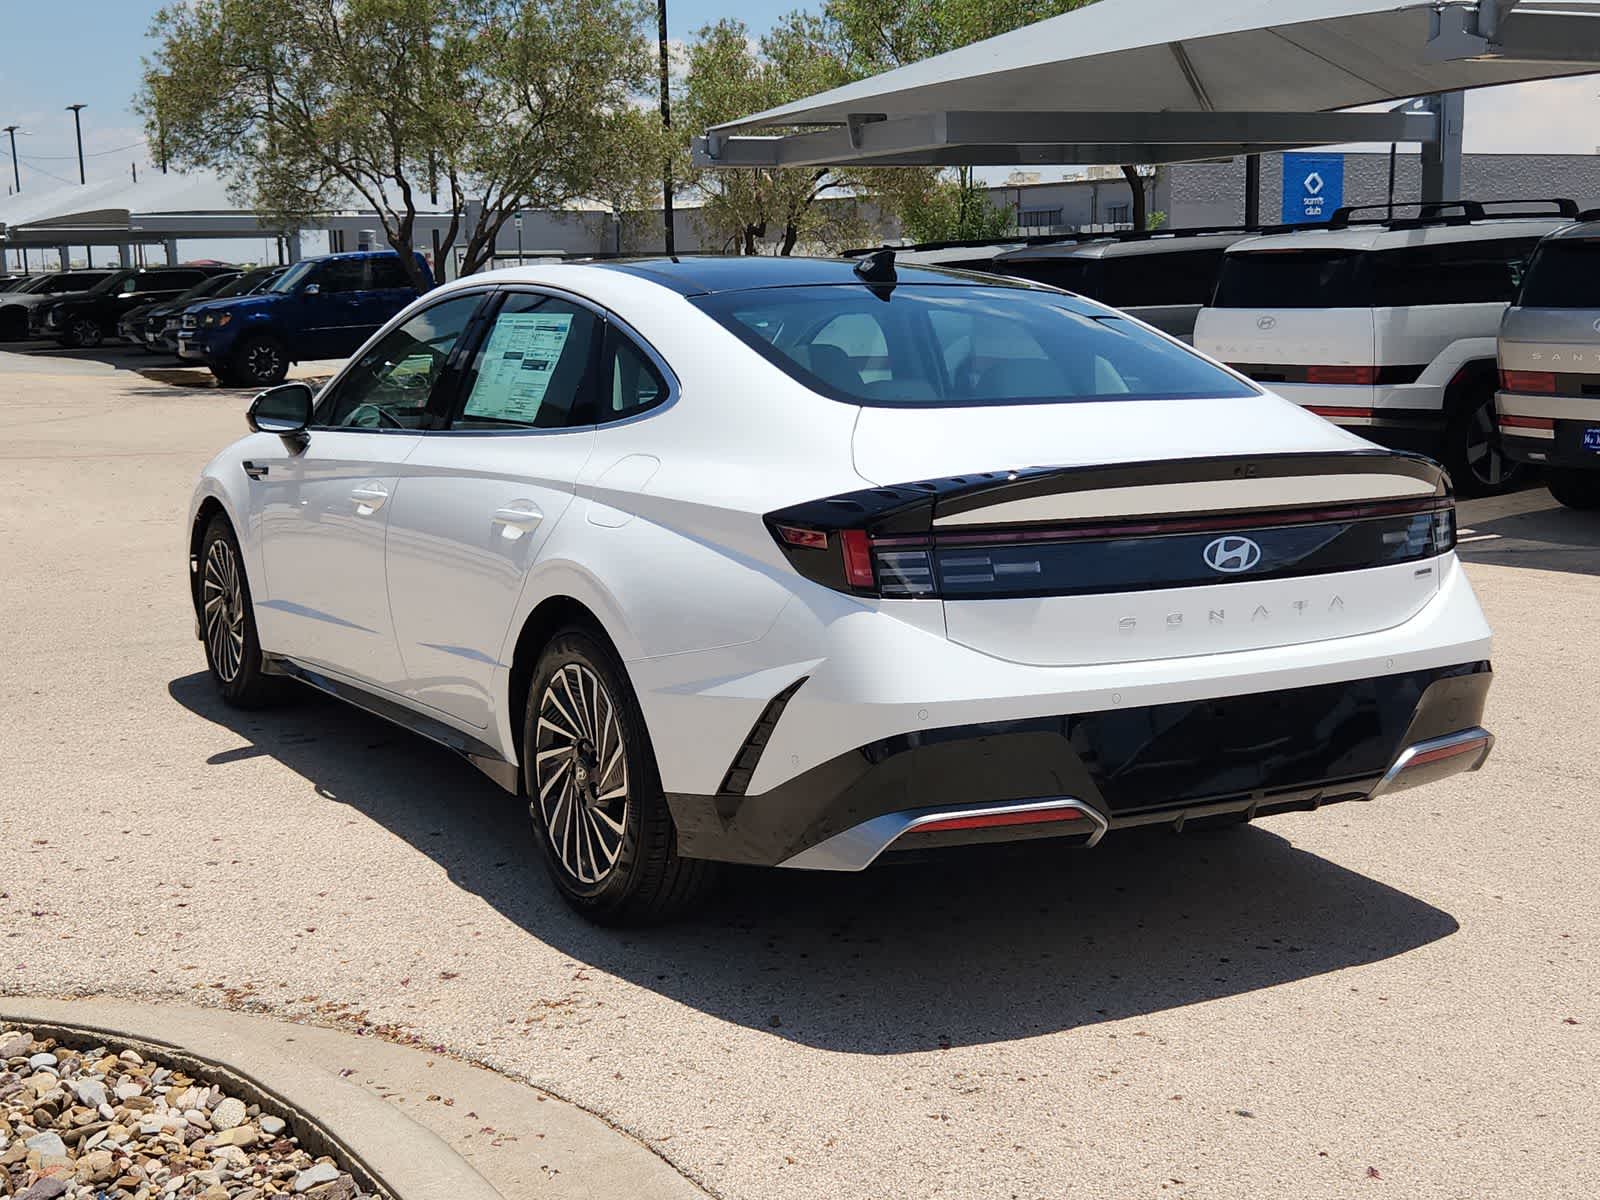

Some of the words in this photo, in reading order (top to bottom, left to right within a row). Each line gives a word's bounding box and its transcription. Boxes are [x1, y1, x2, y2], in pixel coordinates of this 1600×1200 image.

[1304, 197, 1324, 206] sam's
[1305, 206, 1321, 216] club
[1119, 595, 1345, 631] SONATA
